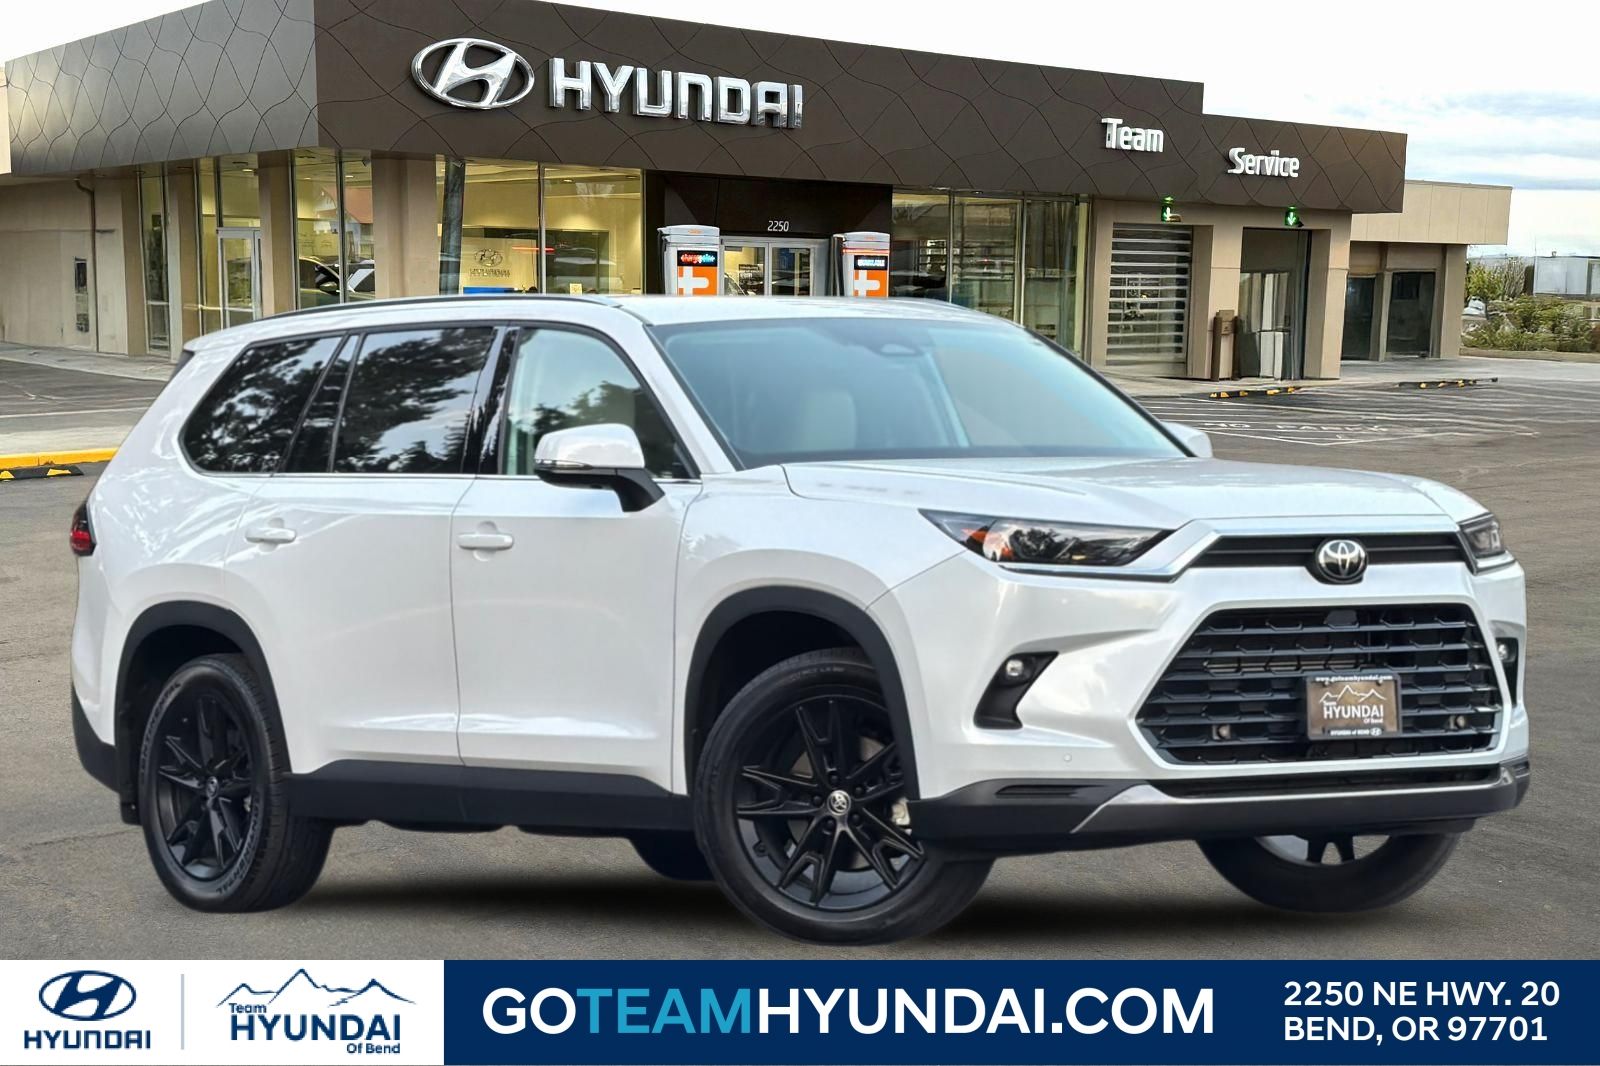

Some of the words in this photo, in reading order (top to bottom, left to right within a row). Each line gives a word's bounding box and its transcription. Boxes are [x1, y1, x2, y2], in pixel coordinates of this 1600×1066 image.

[549, 57, 803, 129] HYUNDAI
[1101, 117, 1164, 153] Team
[1228, 147, 1300, 178] Service
[767, 220, 790, 232] 2250
[1323, 705, 1384, 719] HYUNDAI
